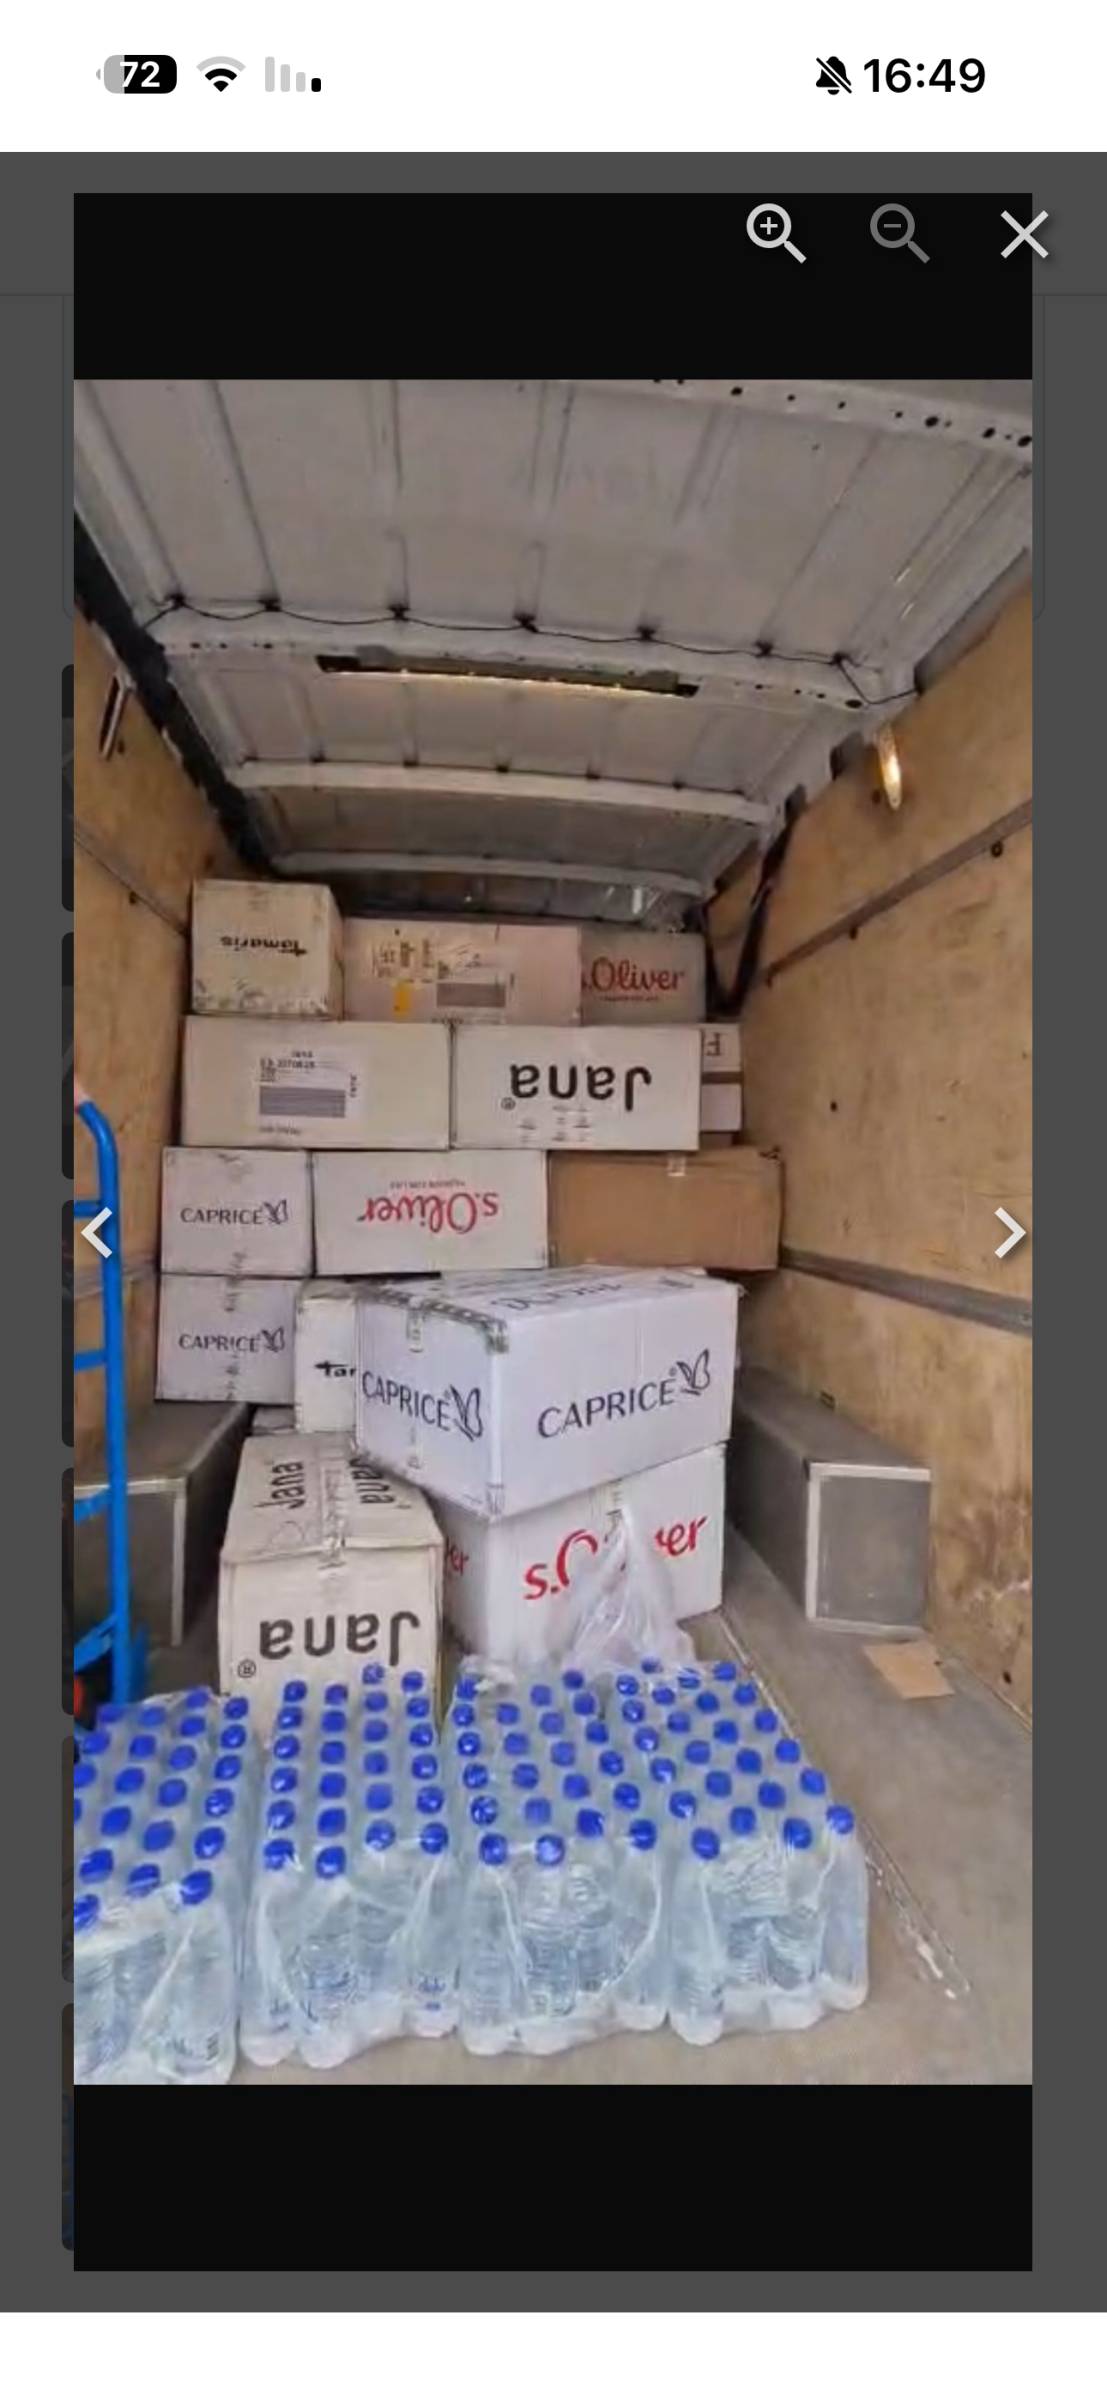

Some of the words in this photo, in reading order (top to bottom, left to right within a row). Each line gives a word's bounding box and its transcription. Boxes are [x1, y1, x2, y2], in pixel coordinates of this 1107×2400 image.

[510, 1063, 652, 1112] Jana
[180, 1206, 262, 1226] CAPRICE
[357, 1192, 499, 1234] s.Oliver
[178, 1333, 259, 1354] CAPRICE
[362, 1370, 450, 1431] CAPRICE
[537, 1379, 676, 1438] CAPRICE
[253, 1462, 305, 1509] Jana
[259, 1611, 420, 1666] Jana
